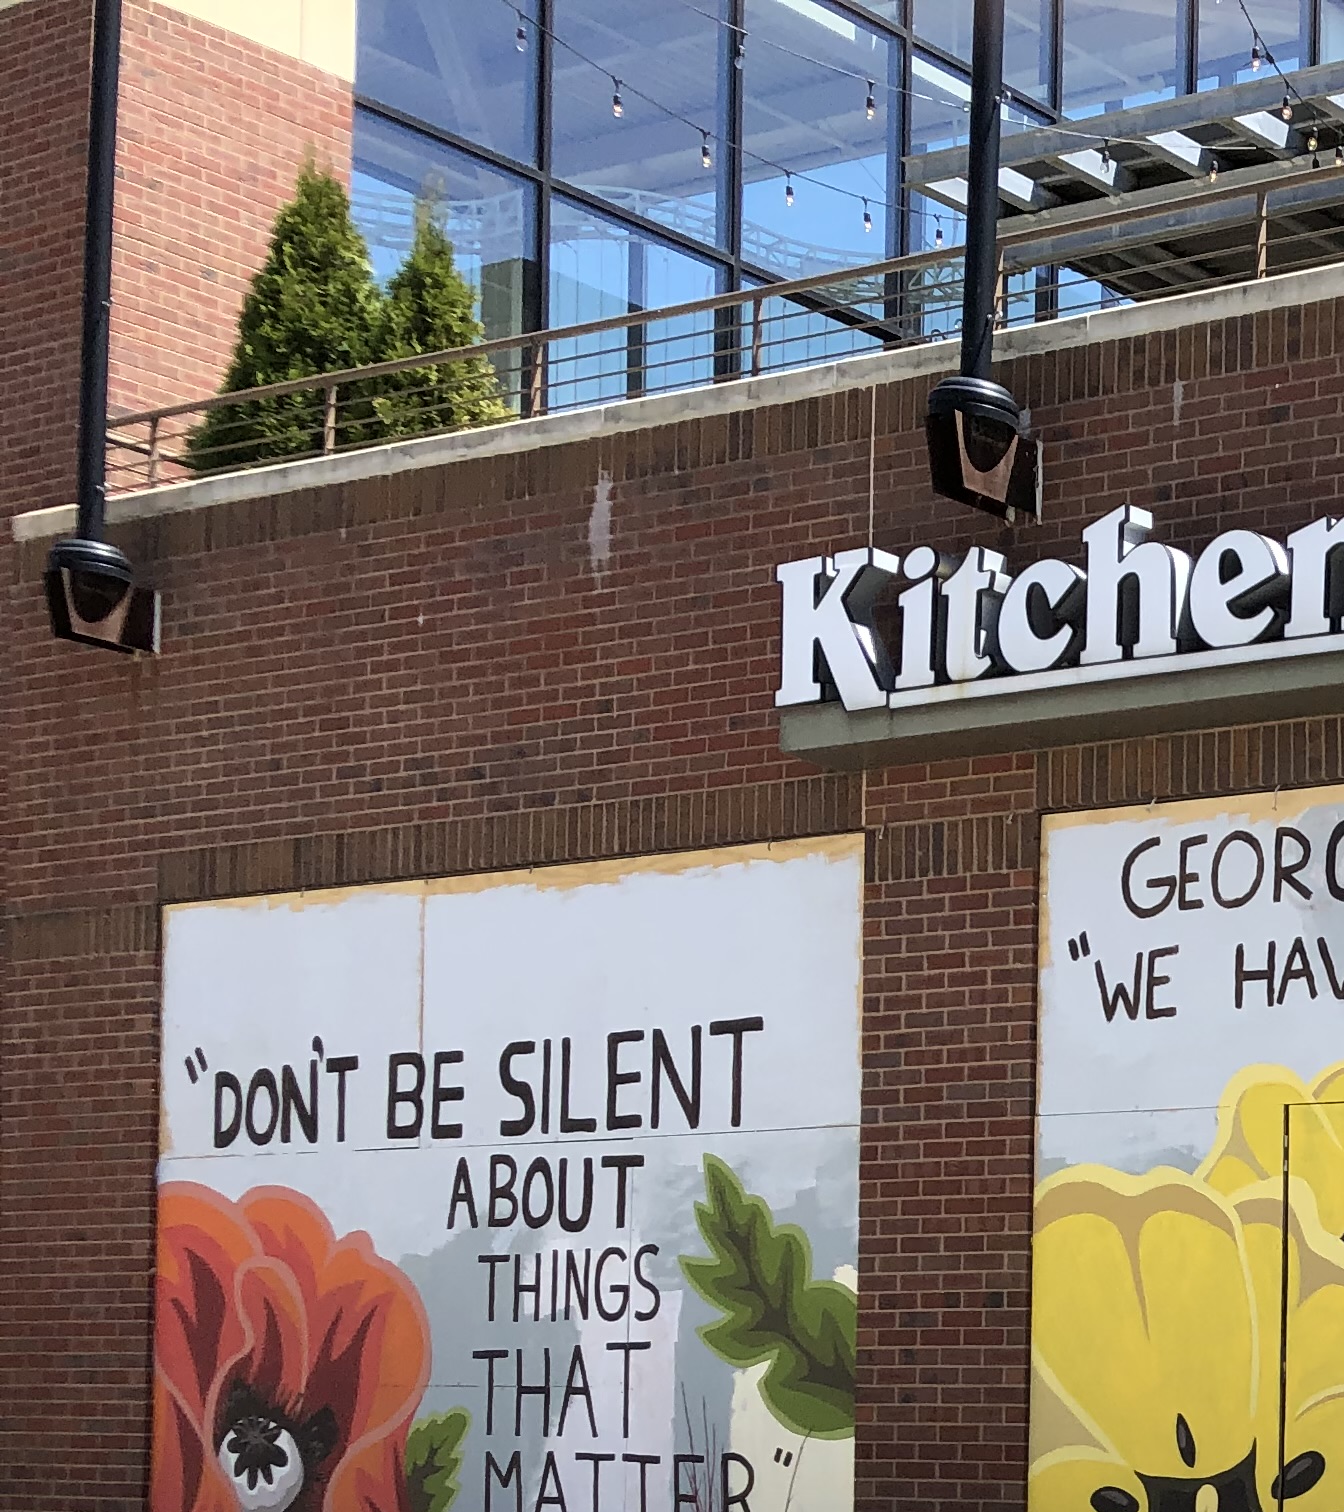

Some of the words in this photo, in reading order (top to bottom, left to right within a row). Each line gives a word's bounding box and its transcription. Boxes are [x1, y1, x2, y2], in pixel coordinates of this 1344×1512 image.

[1067, 931, 1180, 1023] "WE
[386, 1050, 466, 1140] BE
[498, 1016, 764, 1137] SILENT
[447, 1154, 645, 1231] ABOUT
[477, 1244, 661, 1323] THINGS
[471, 1341, 652, 1439] THAT
